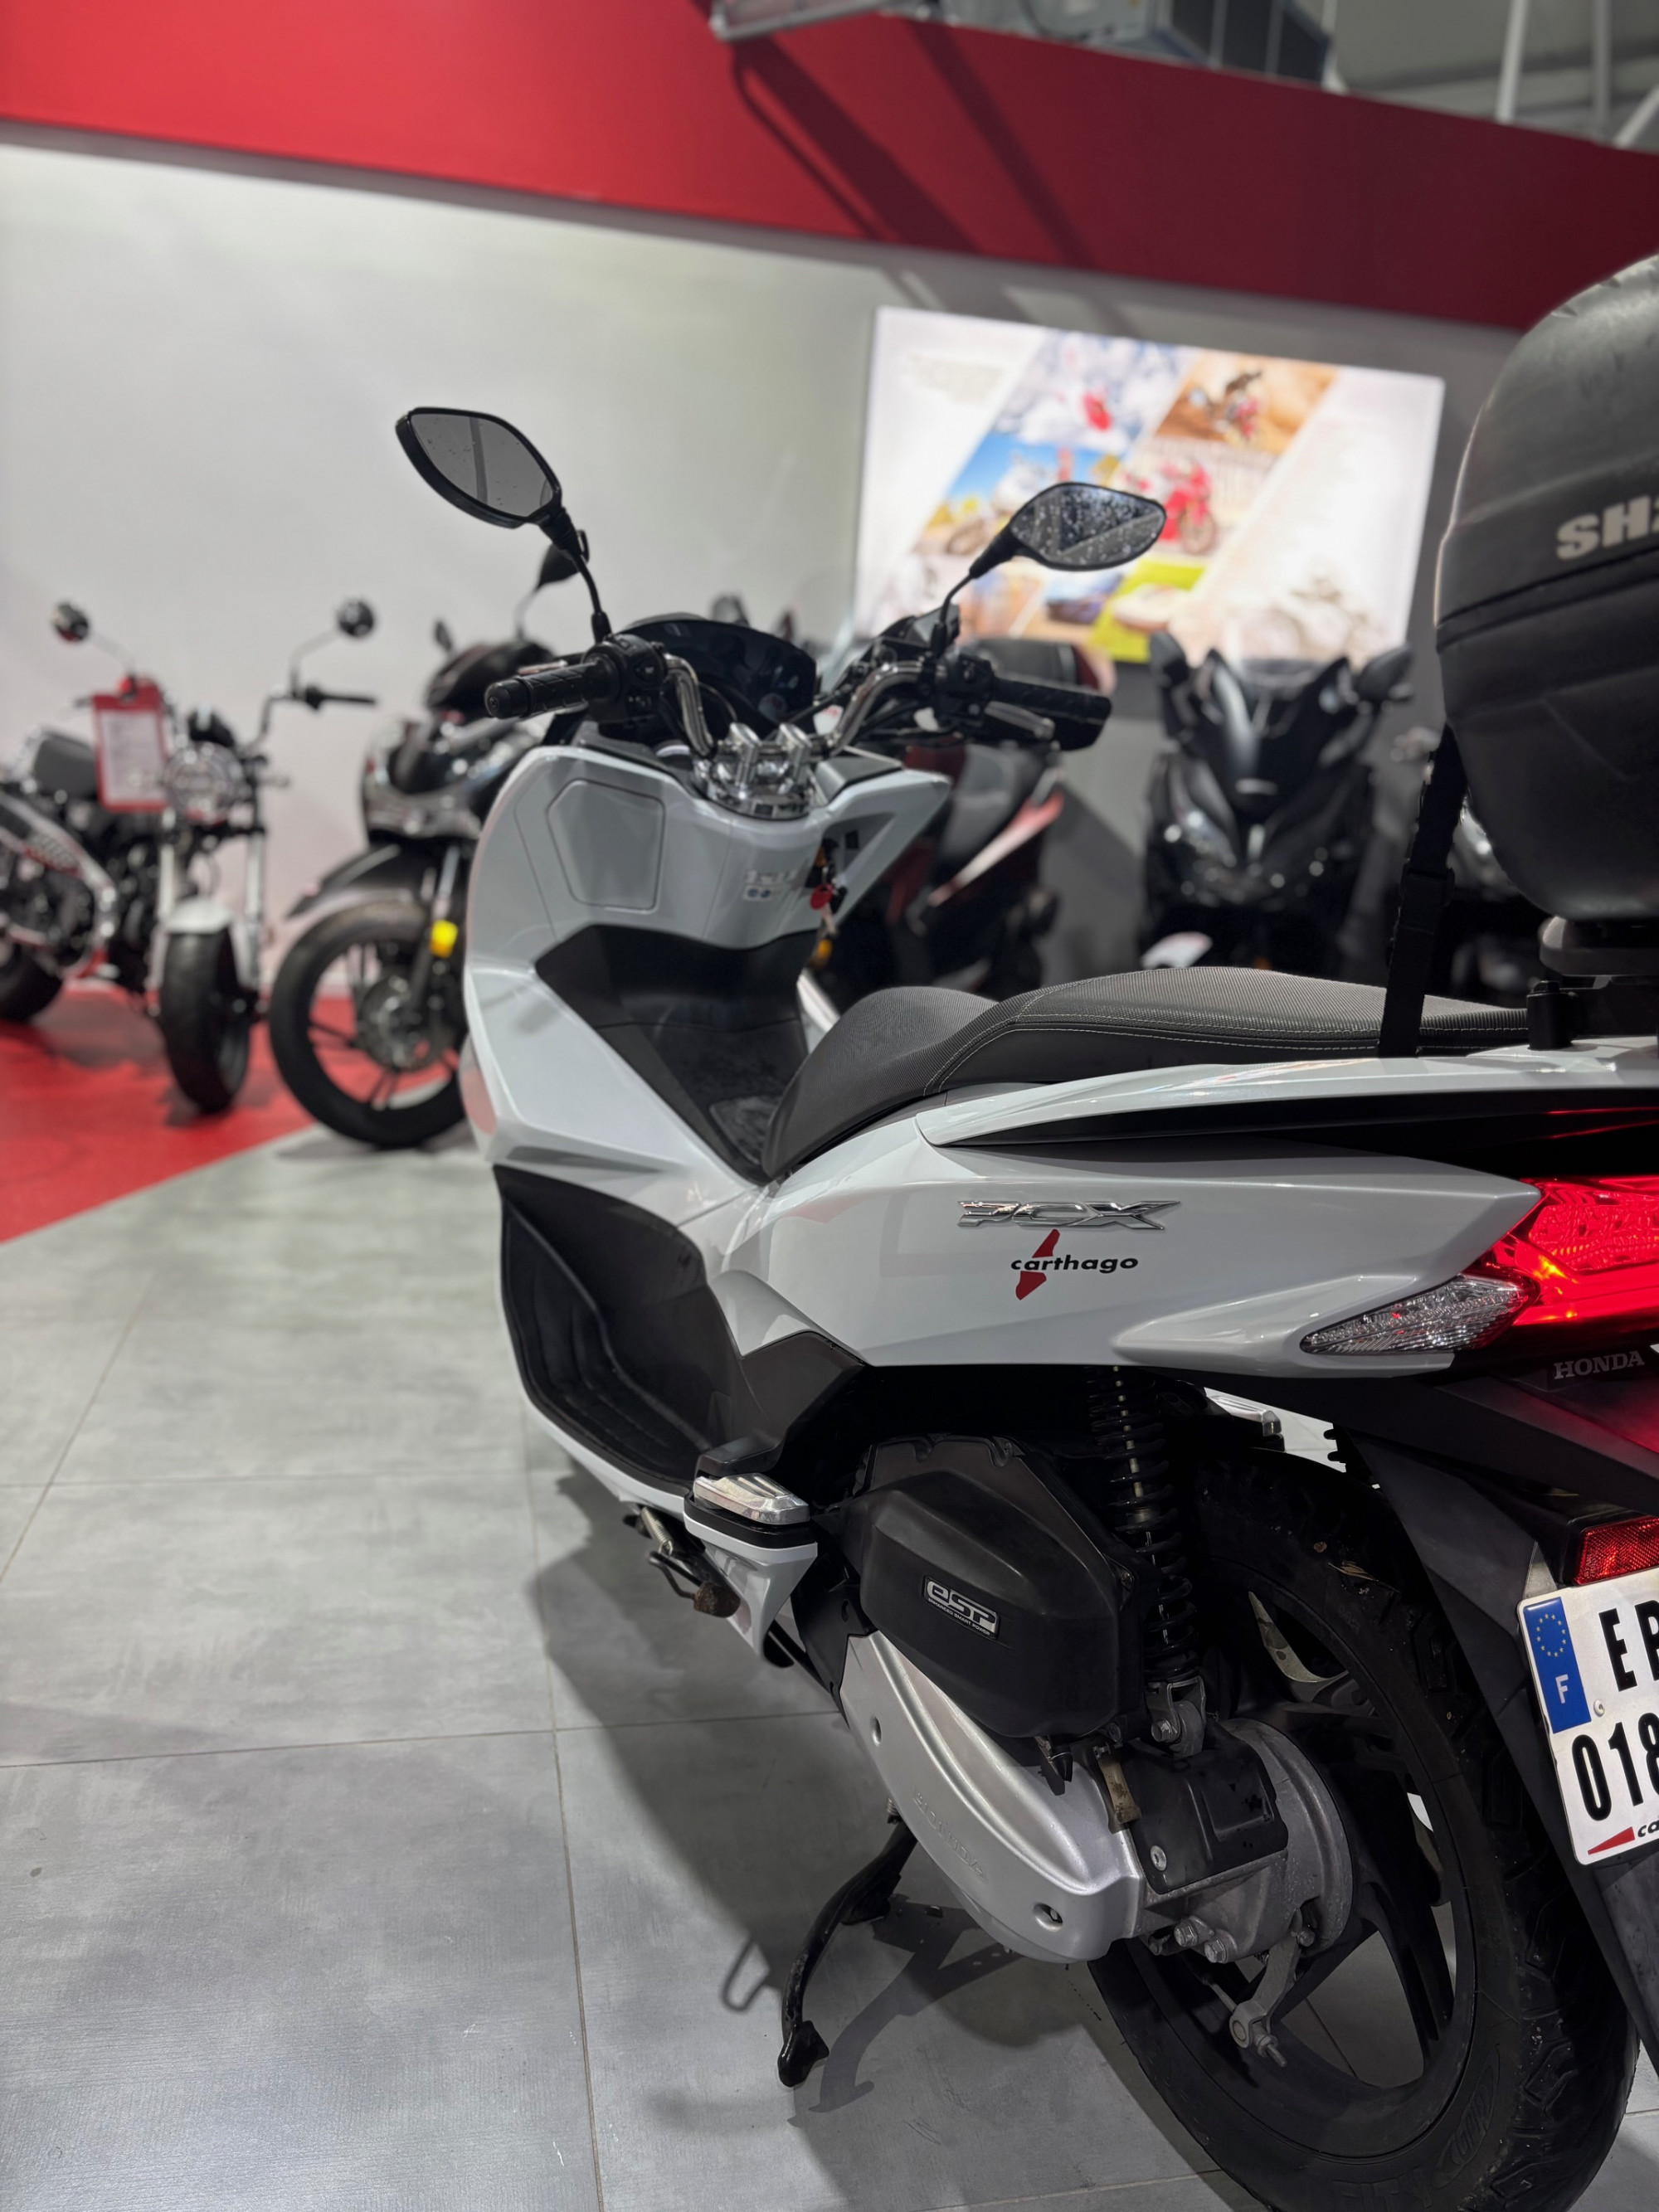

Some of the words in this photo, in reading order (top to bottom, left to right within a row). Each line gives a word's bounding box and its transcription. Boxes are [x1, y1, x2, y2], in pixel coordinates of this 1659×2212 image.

[1556, 496, 1659, 560] SH
[957, 1200, 1180, 1230] PCX
[1010, 1254, 1138, 1274] carthago
[1554, 1350, 1645, 1379] HONDA
[954, 1612, 971, 1626] SMART
[1555, 1674, 1569, 1704] F
[1571, 1712, 1659, 1821] 018
